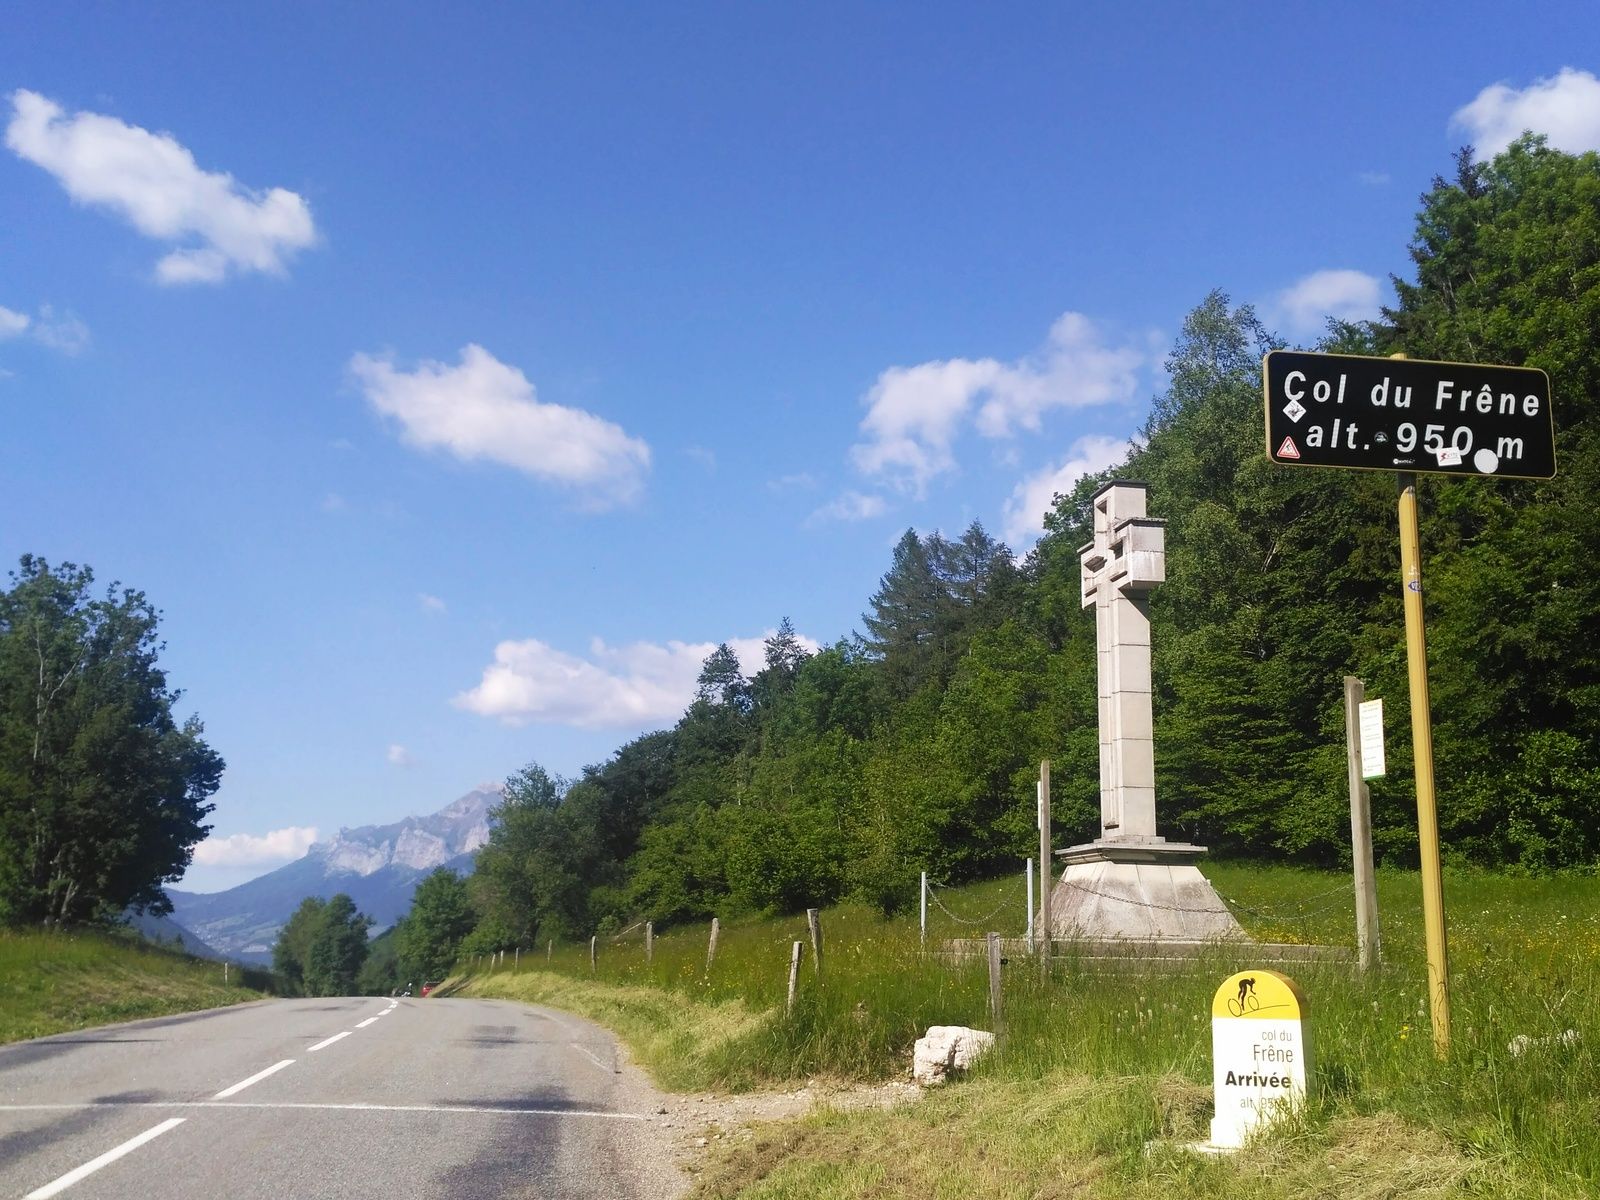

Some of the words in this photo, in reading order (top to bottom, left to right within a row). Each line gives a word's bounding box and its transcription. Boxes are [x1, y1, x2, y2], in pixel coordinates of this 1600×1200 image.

[1284, 370, 1347, 403] Col
[1371, 377, 1412, 408] du
[1436, 380, 1540, 417] Frêne
[1306, 418, 1371, 450] alt.
[1396, 422, 1474, 457] 950
[1496, 436, 1524, 459] m
[1262, 1029, 1276, 1041] col
[1280, 1030, 1292, 1041] du
[1253, 1044, 1294, 1063] Frêne
[1225, 1070, 1292, 1088] Arrivée
